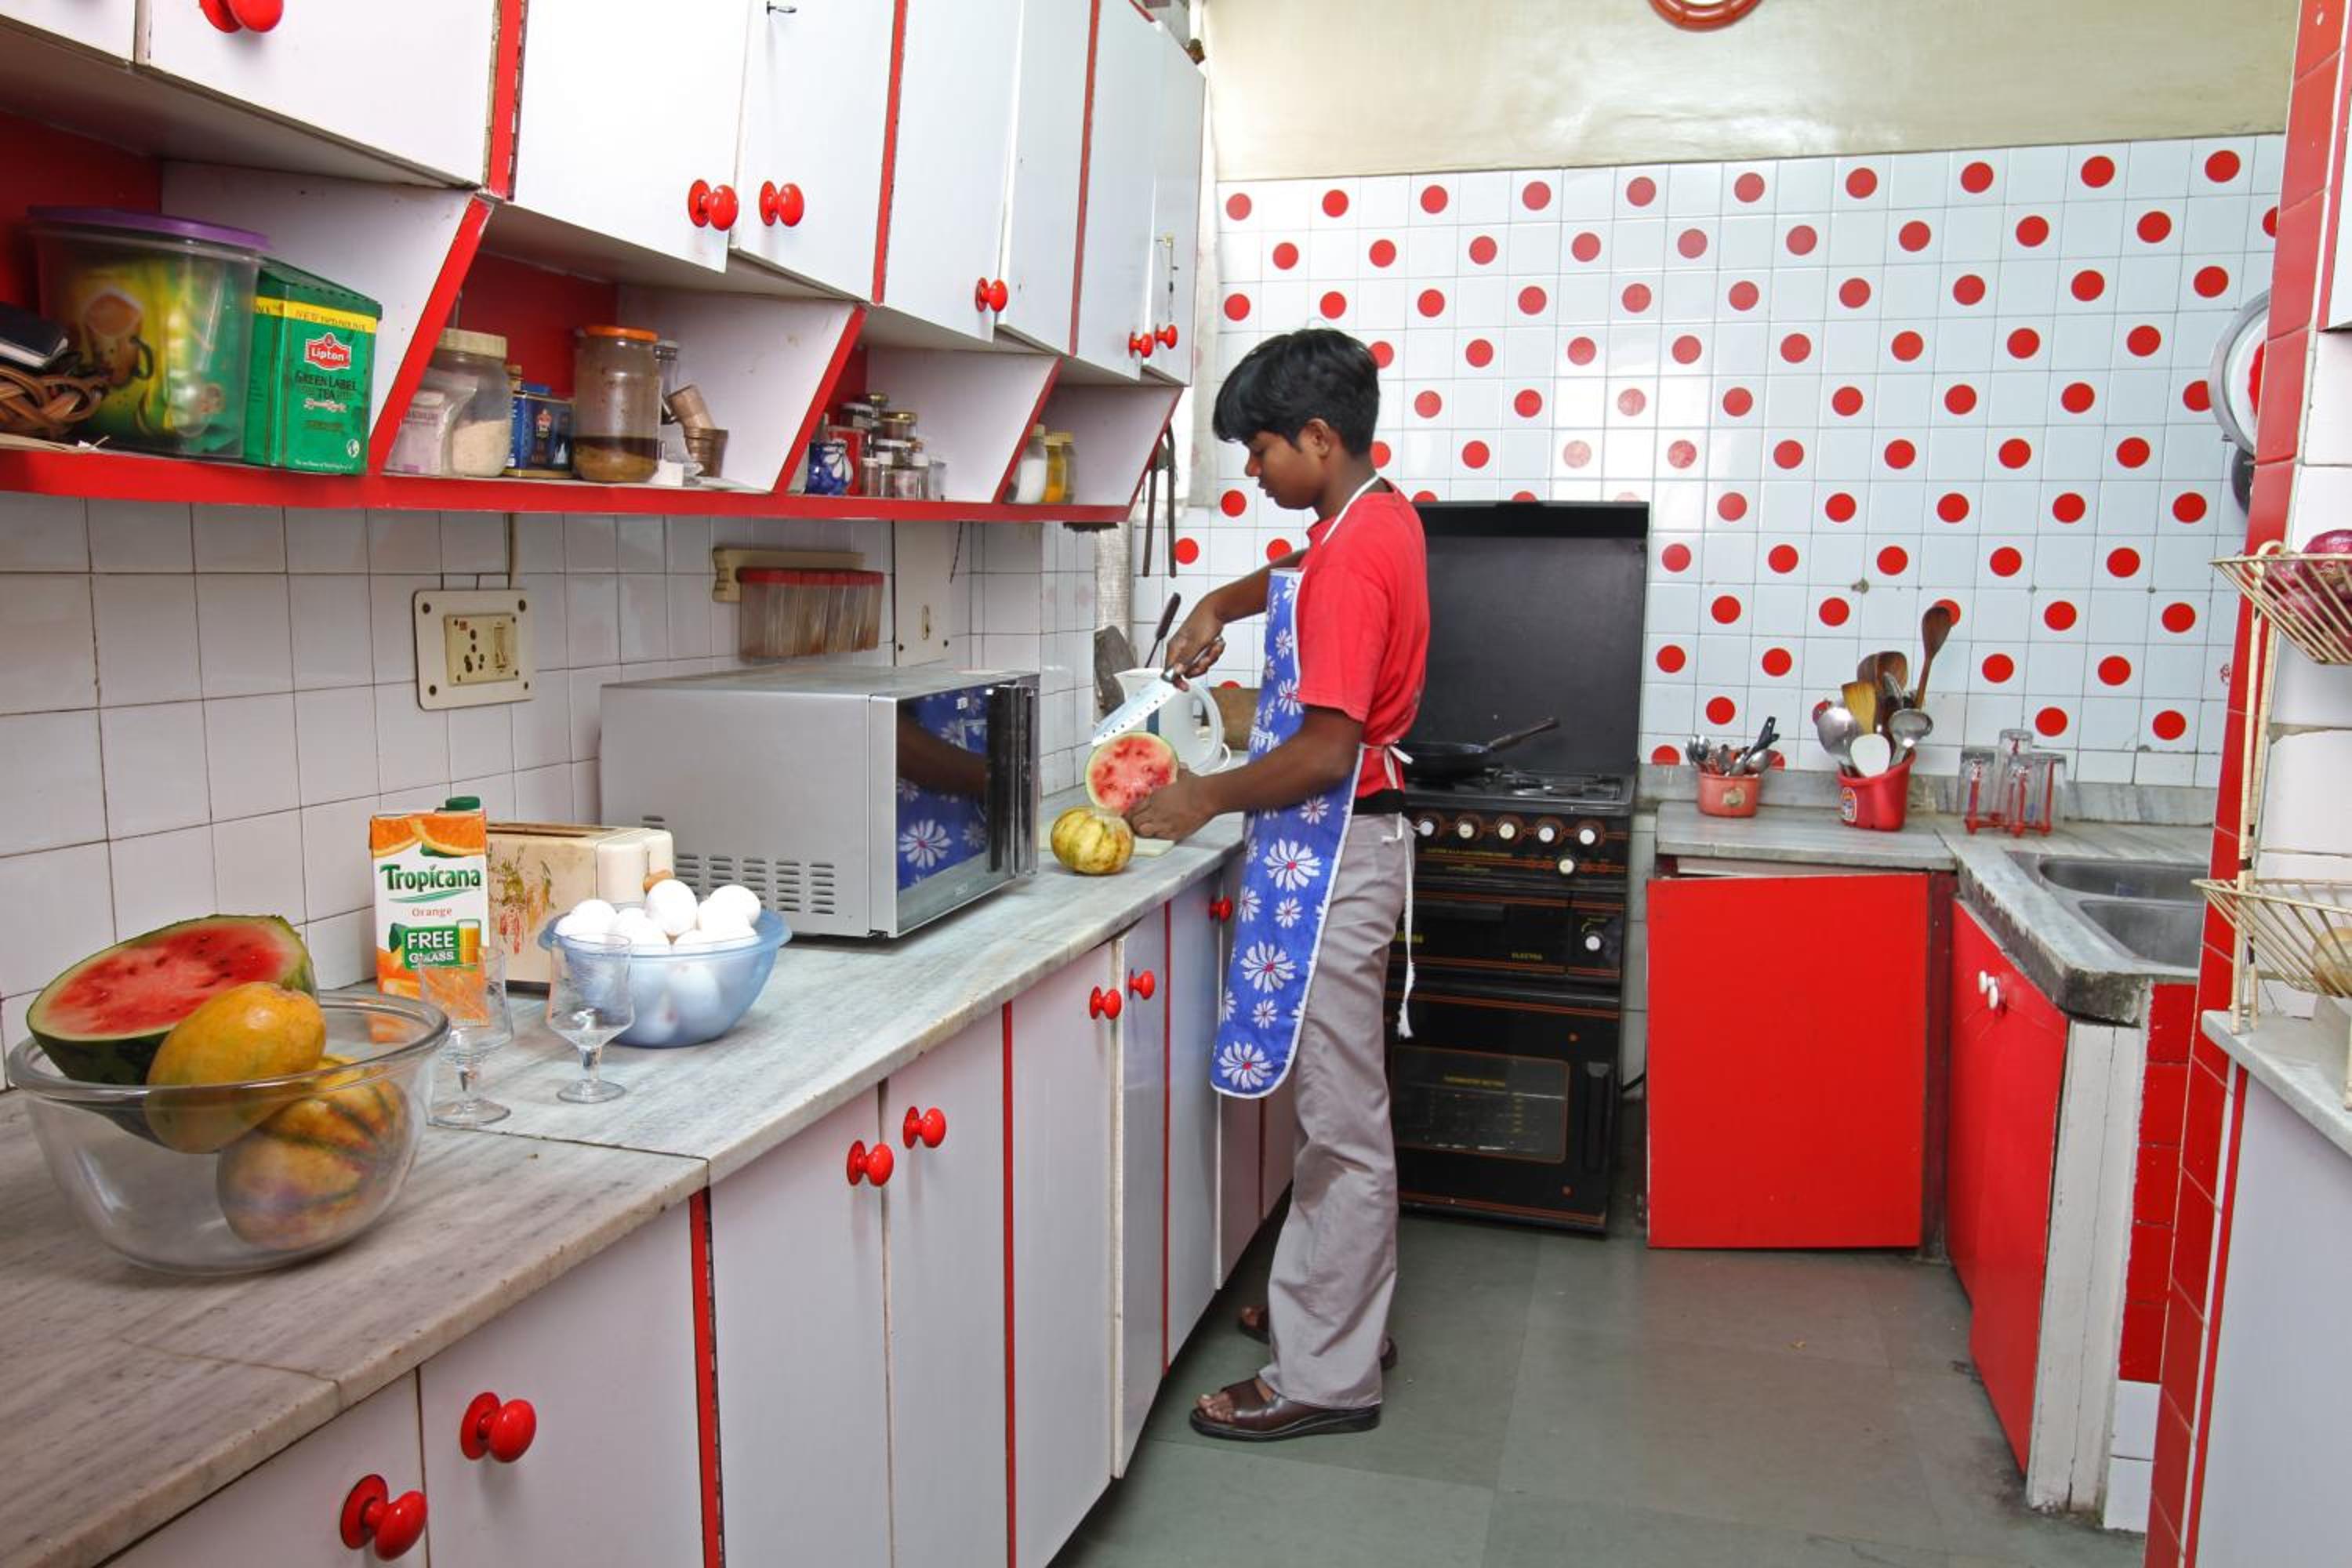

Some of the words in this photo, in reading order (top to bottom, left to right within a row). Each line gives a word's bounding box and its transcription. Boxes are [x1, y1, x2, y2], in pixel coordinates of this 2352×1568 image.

[311, 348, 344, 361] Lipton
[296, 371, 327, 385] GREEN
[329, 375, 357, 390] LABEL
[318, 388, 335, 401] TEA
[379, 864, 481, 892] Tropicana
[412, 907, 452, 918] Orange
[407, 931, 455, 949] FREE
